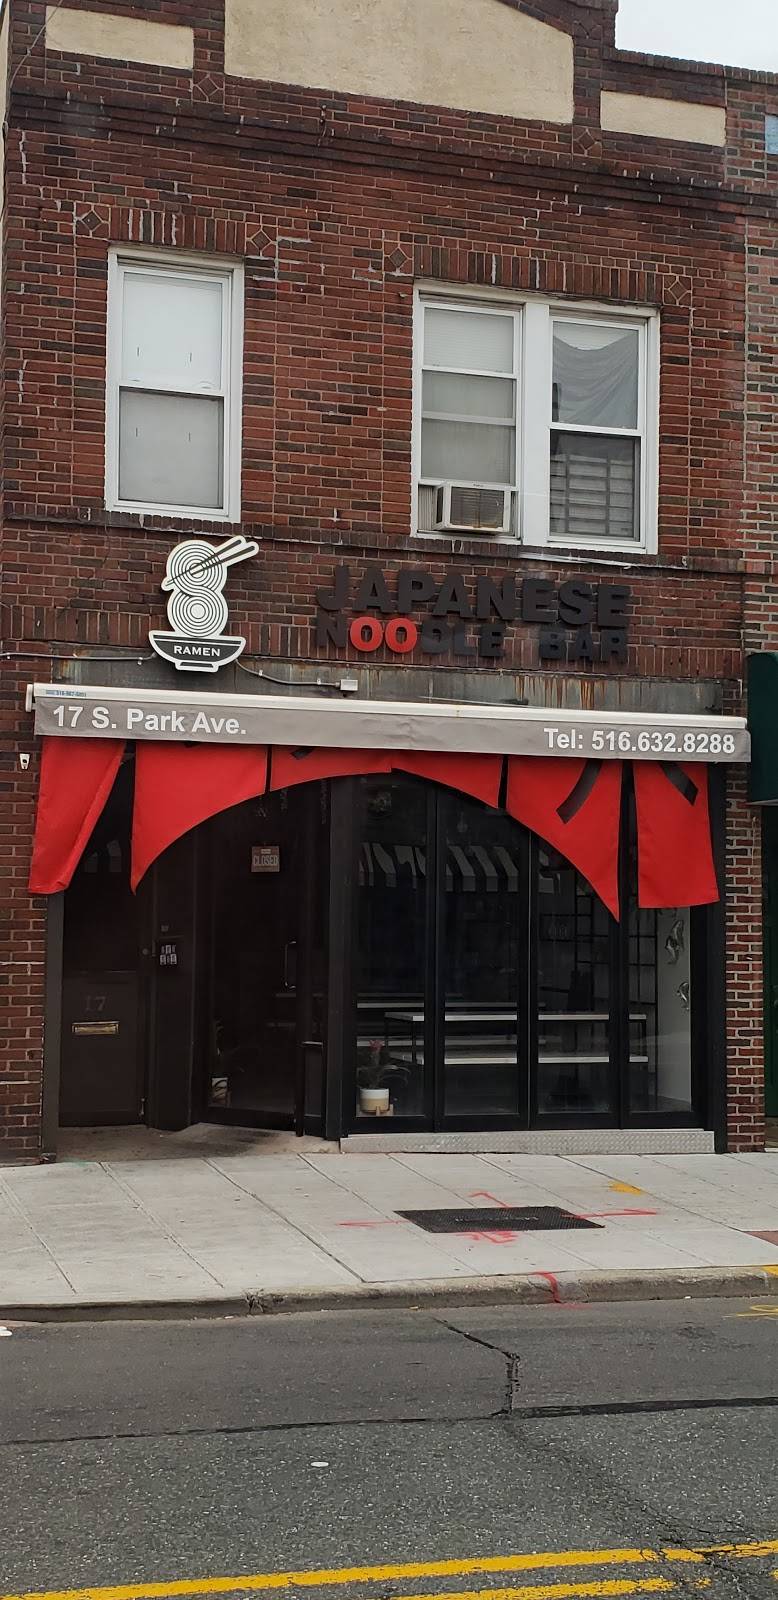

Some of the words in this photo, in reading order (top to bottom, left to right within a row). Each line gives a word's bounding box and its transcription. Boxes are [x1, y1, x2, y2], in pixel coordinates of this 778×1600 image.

[316, 565, 631, 627] JAPANESE
[173, 645, 221, 657] RAMEN
[316, 613, 506, 657] NOODLE
[539, 628, 628, 663] BAR
[53, 705, 83, 727] 17
[91, 706, 117, 729] S.
[127, 708, 185, 732] Park
[191, 711, 247, 735] Ave.
[543, 727, 583, 750] Tel:
[591, 730, 736, 754] 516.632.8288
[253, 854, 278, 867] CLOSED
[84, 995, 106, 1012] 17
